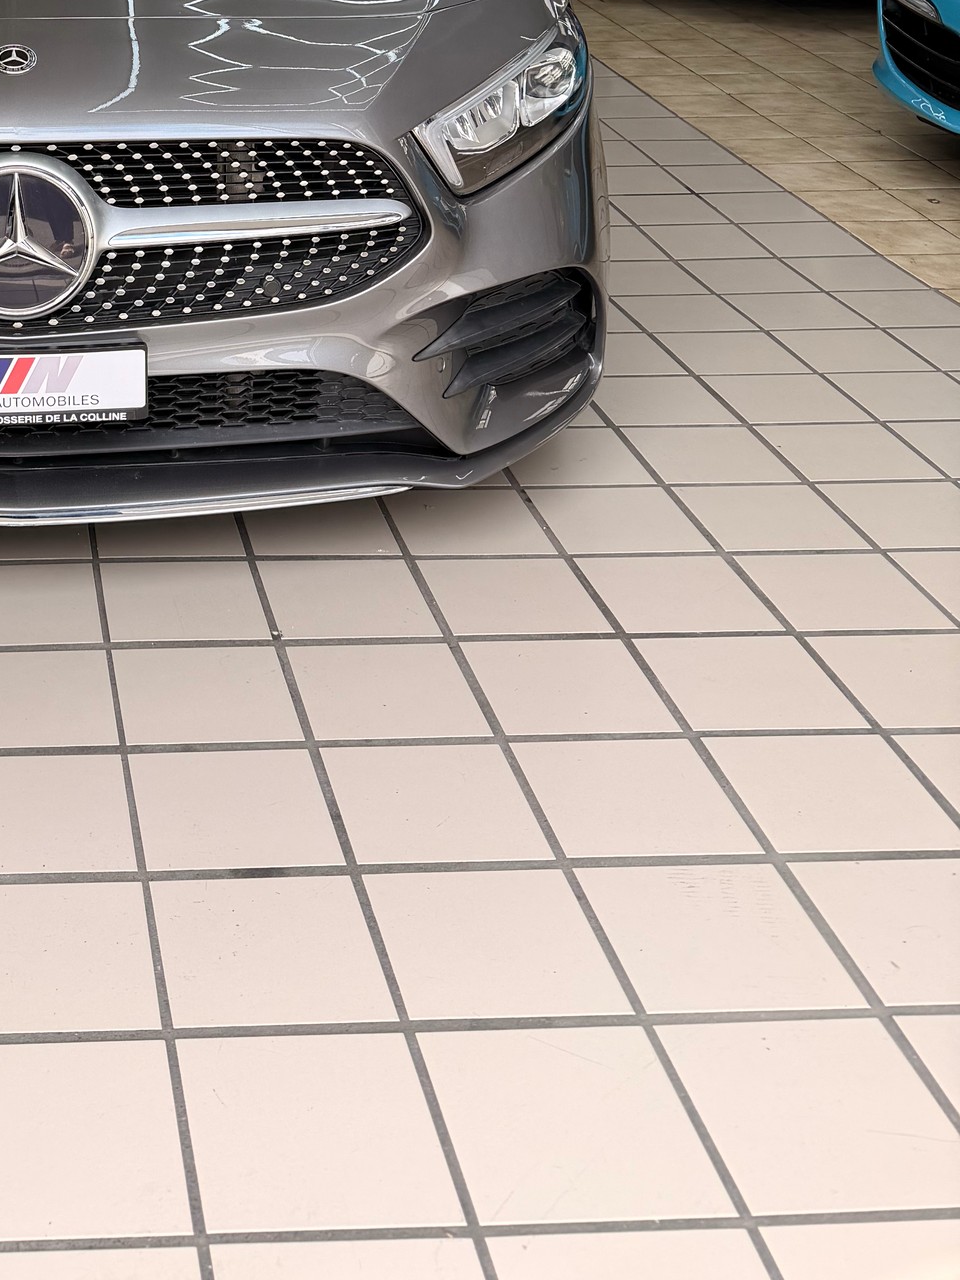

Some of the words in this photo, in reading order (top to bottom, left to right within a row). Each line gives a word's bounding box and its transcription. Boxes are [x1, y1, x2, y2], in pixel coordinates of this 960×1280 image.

[45, 413, 60, 423] DE
[63, 413, 78, 423] LA
[80, 412, 127, 423] COLLINE
